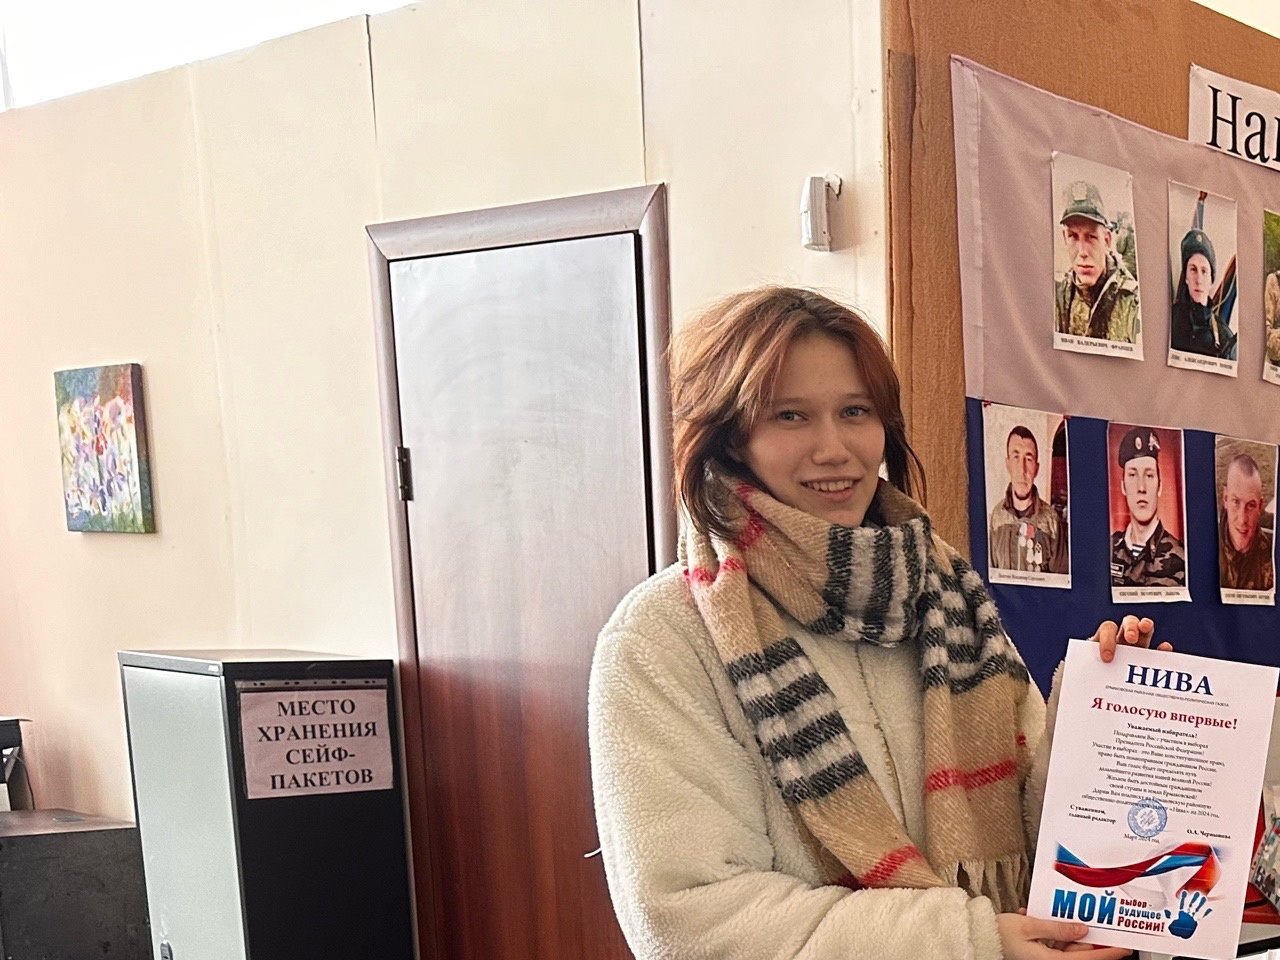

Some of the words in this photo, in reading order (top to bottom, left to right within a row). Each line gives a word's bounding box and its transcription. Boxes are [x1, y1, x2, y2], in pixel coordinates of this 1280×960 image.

[1125, 664, 1214, 696] НИВА
[277, 699, 356, 717] МЕСТО
[1091, 696, 1103, 709] Я
[1105, 702, 1167, 720] голосую
[1169, 711, 1237, 730] впервые!
[257, 721, 378, 743] ХРАНЕНИЯ
[285, 743, 356, 765] СЕЙФ-
[270, 768, 373, 790] ПАКЕТОВ
[1051, 888, 1117, 926] МОЙ
[1118, 906, 1162, 920] будущее
